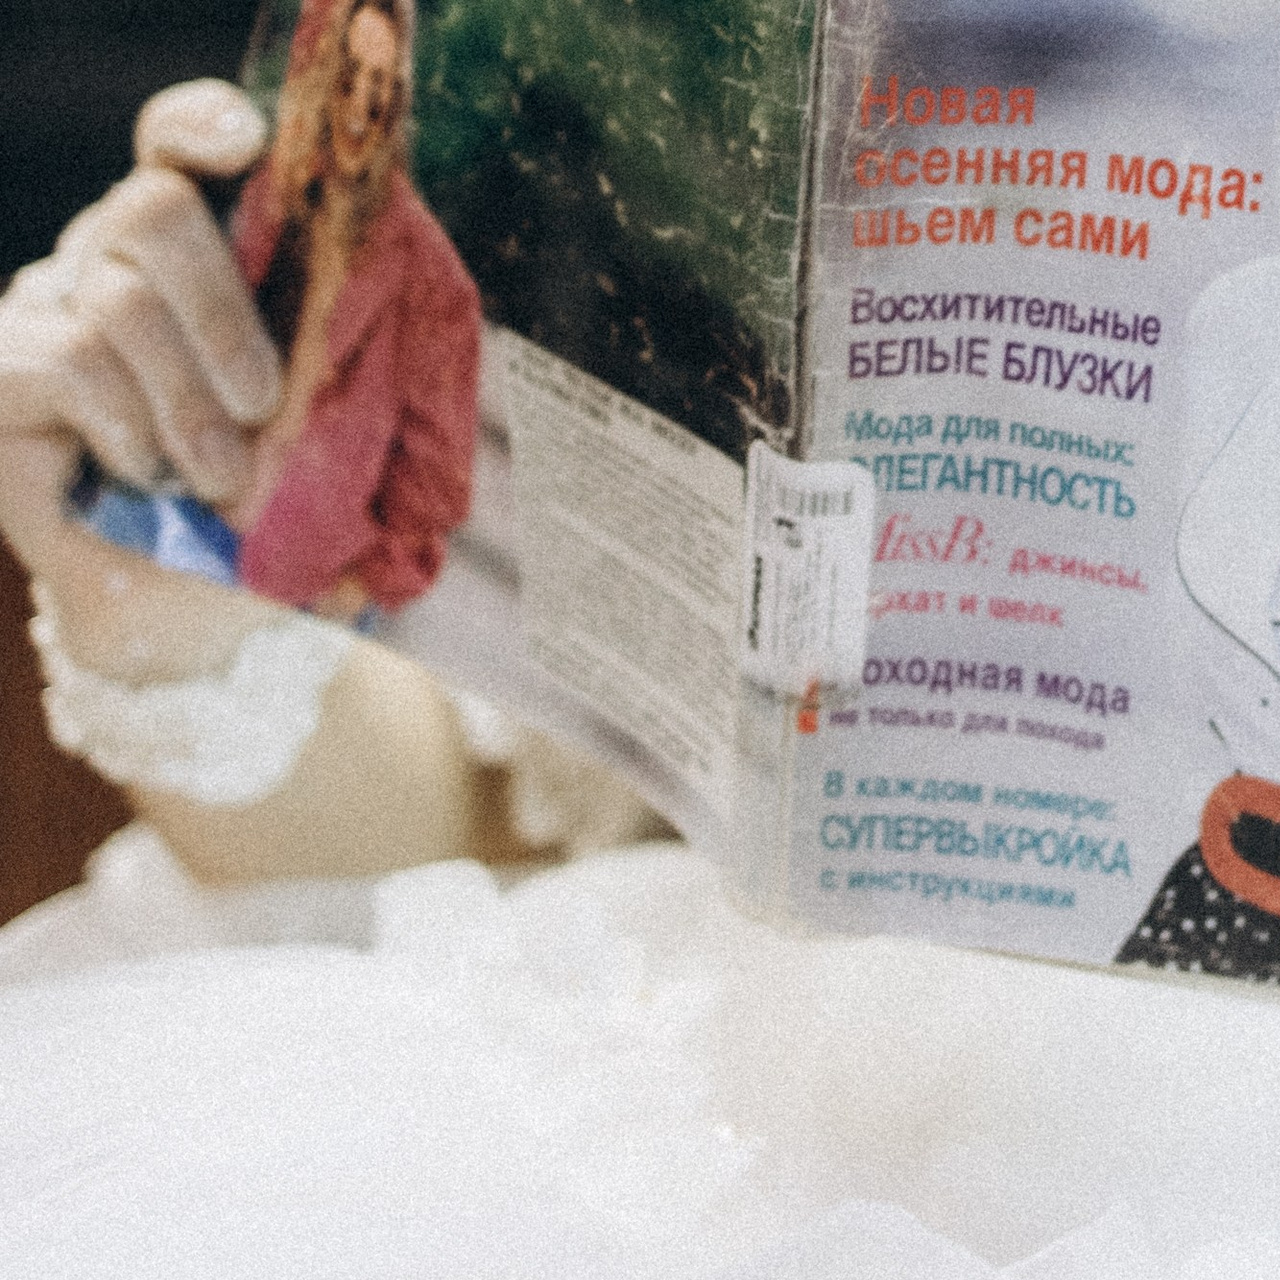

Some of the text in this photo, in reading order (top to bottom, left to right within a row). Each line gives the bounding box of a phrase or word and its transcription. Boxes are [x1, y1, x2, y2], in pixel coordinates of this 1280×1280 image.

[860, 75, 1036, 126] Новая
[854, 146, 1263, 219] осенняя мода:
[853, 206, 1150, 260] шьем сами
[851, 288, 1161, 345] Восхитительные
[848, 337, 1153, 403] БЕЛЫЕ БЛУЗКИ
[846, 409, 1134, 467] Мода для полных:
[852, 452, 1136, 517] ЛЕГАНТНОСТЬ
[958, 594, 978, 614] и
[862, 657, 1130, 716] оходная мода
[823, 769, 845, 799] В
[855, 777, 983, 804] каждом
[820, 814, 1131, 877] СУПЕРВЫКРОЙКА
[819, 870, 838, 892] с
